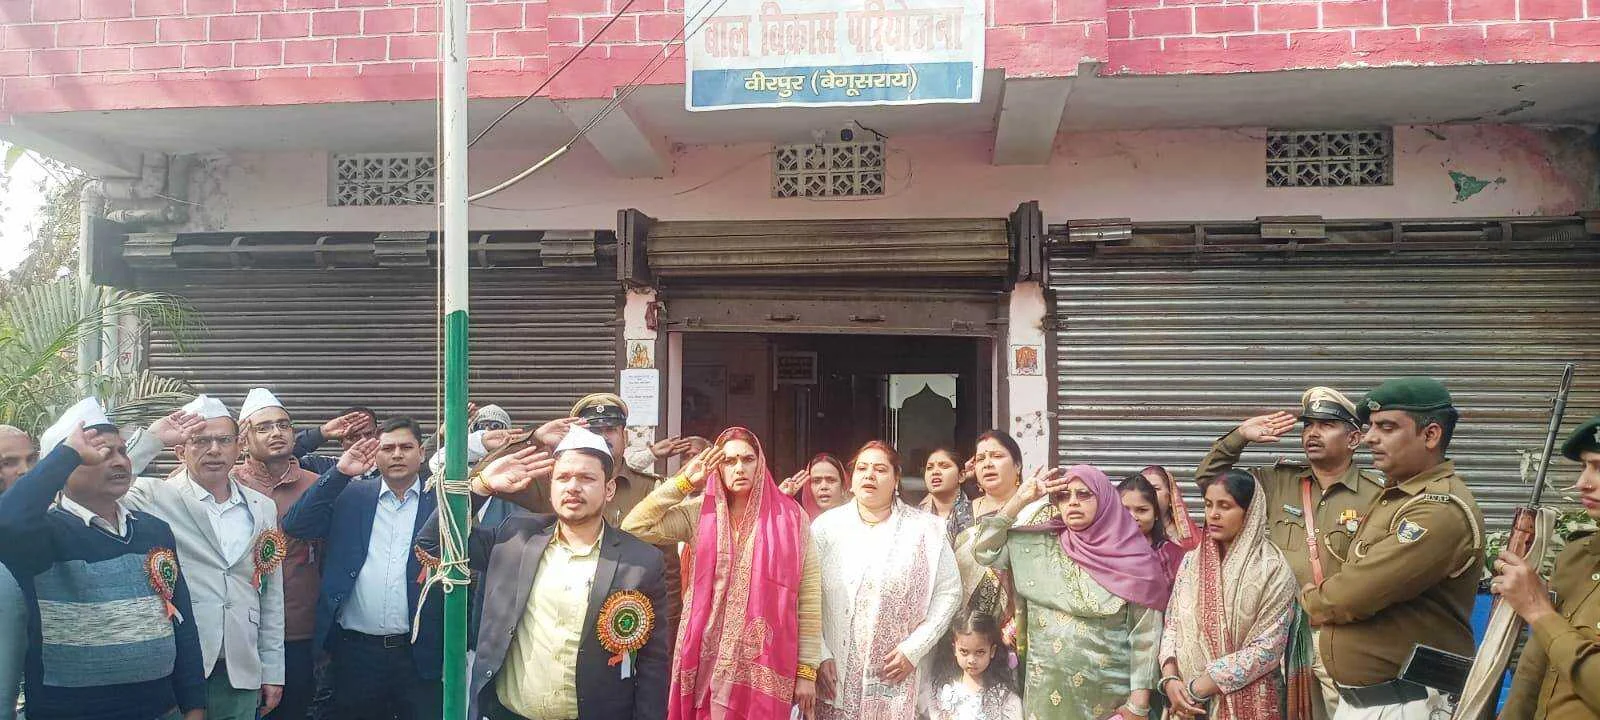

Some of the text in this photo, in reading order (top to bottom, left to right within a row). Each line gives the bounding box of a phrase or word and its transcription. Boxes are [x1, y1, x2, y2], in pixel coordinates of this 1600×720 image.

[703, 0, 964, 58] बाल विकास परियोजना
[744, 65, 918, 97] वीरपुर (बेगूसराय)
